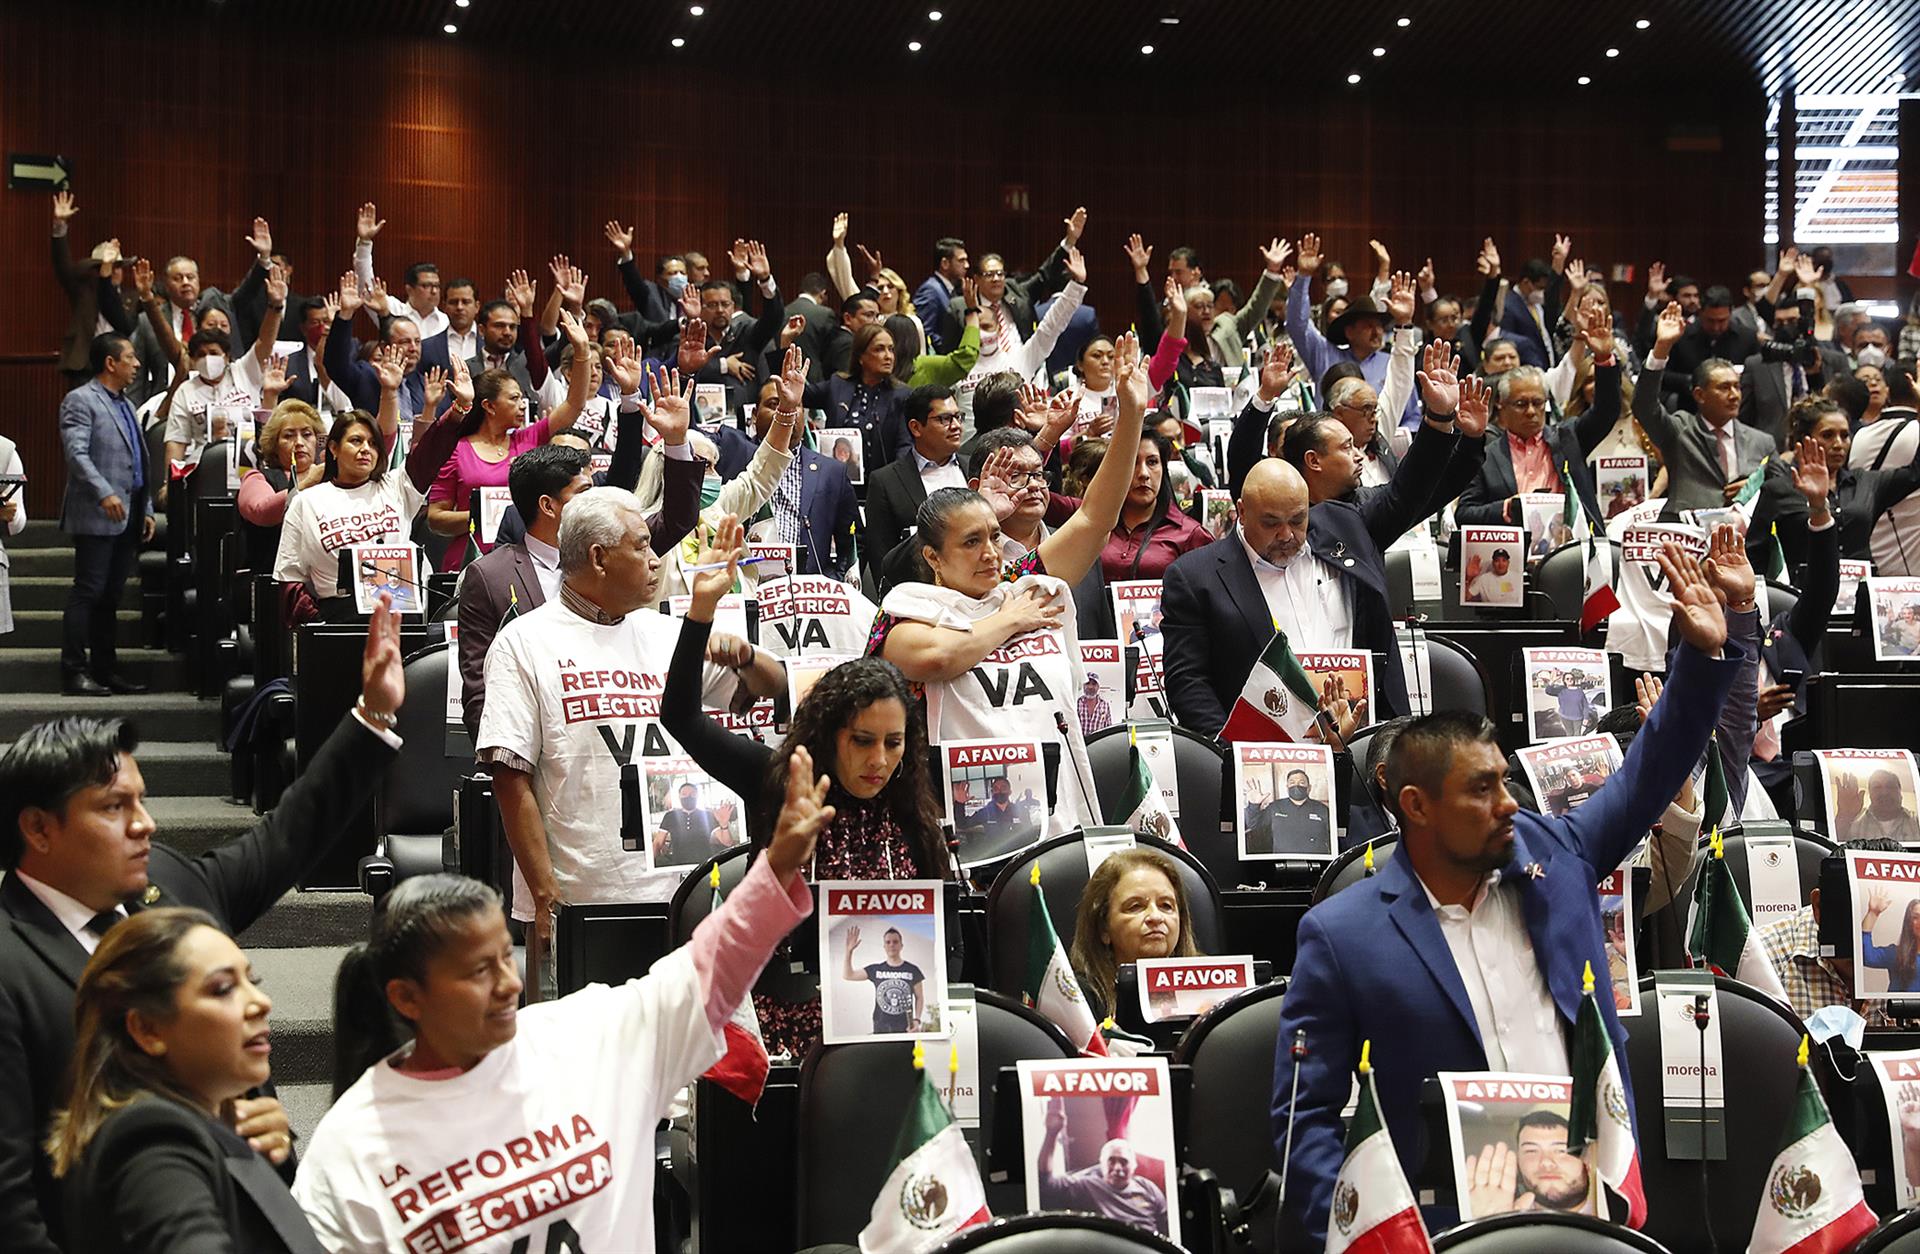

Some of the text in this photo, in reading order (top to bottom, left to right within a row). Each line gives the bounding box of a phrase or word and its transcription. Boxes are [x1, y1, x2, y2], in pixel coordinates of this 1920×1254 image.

[1611, 459, 1641, 467] FAVOR
[319, 504, 396, 535] REFORMA
[322, 518, 400, 551] ELÉCTRICA
[1470, 532, 1515, 541] A FAVOR
[1623, 530, 1707, 550] REFORMA
[362, 550, 408, 558] A FAVOR
[752, 550, 787, 560] FAVOR
[1123, 587, 1163, 597] A FAV
[775, 618, 831, 650] VA
[986, 636, 1059, 662] TRICA
[1082, 648, 1113, 660] VOR
[1536, 652, 1596, 661] A FAVOR
[558, 659, 576, 669] LA
[1302, 656, 1360, 668] A FAVOR
[971, 661, 1054, 707] VA
[566, 694, 661, 721] ELÉCTRI
[597, 723, 671, 767] VA
[1535, 740, 1604, 762] A FAVOR
[957, 747, 1028, 763] A FAVOR
[1249, 750, 1319, 760] A FAVOR
[1864, 862, 1920, 878] A FAV
[838, 894, 925, 911] A FAVOR
[1755, 903, 1797, 912] morena
[1156, 968, 1238, 987] A FAVOR
[1043, 1073, 1149, 1092] A FAVOR
[1466, 1082, 1566, 1099] A FAVOR
[379, 1164, 410, 1188] LA
[392, 1114, 596, 1224] REFORMA
[409, 1154, 612, 1254] ELÉCTRICA
